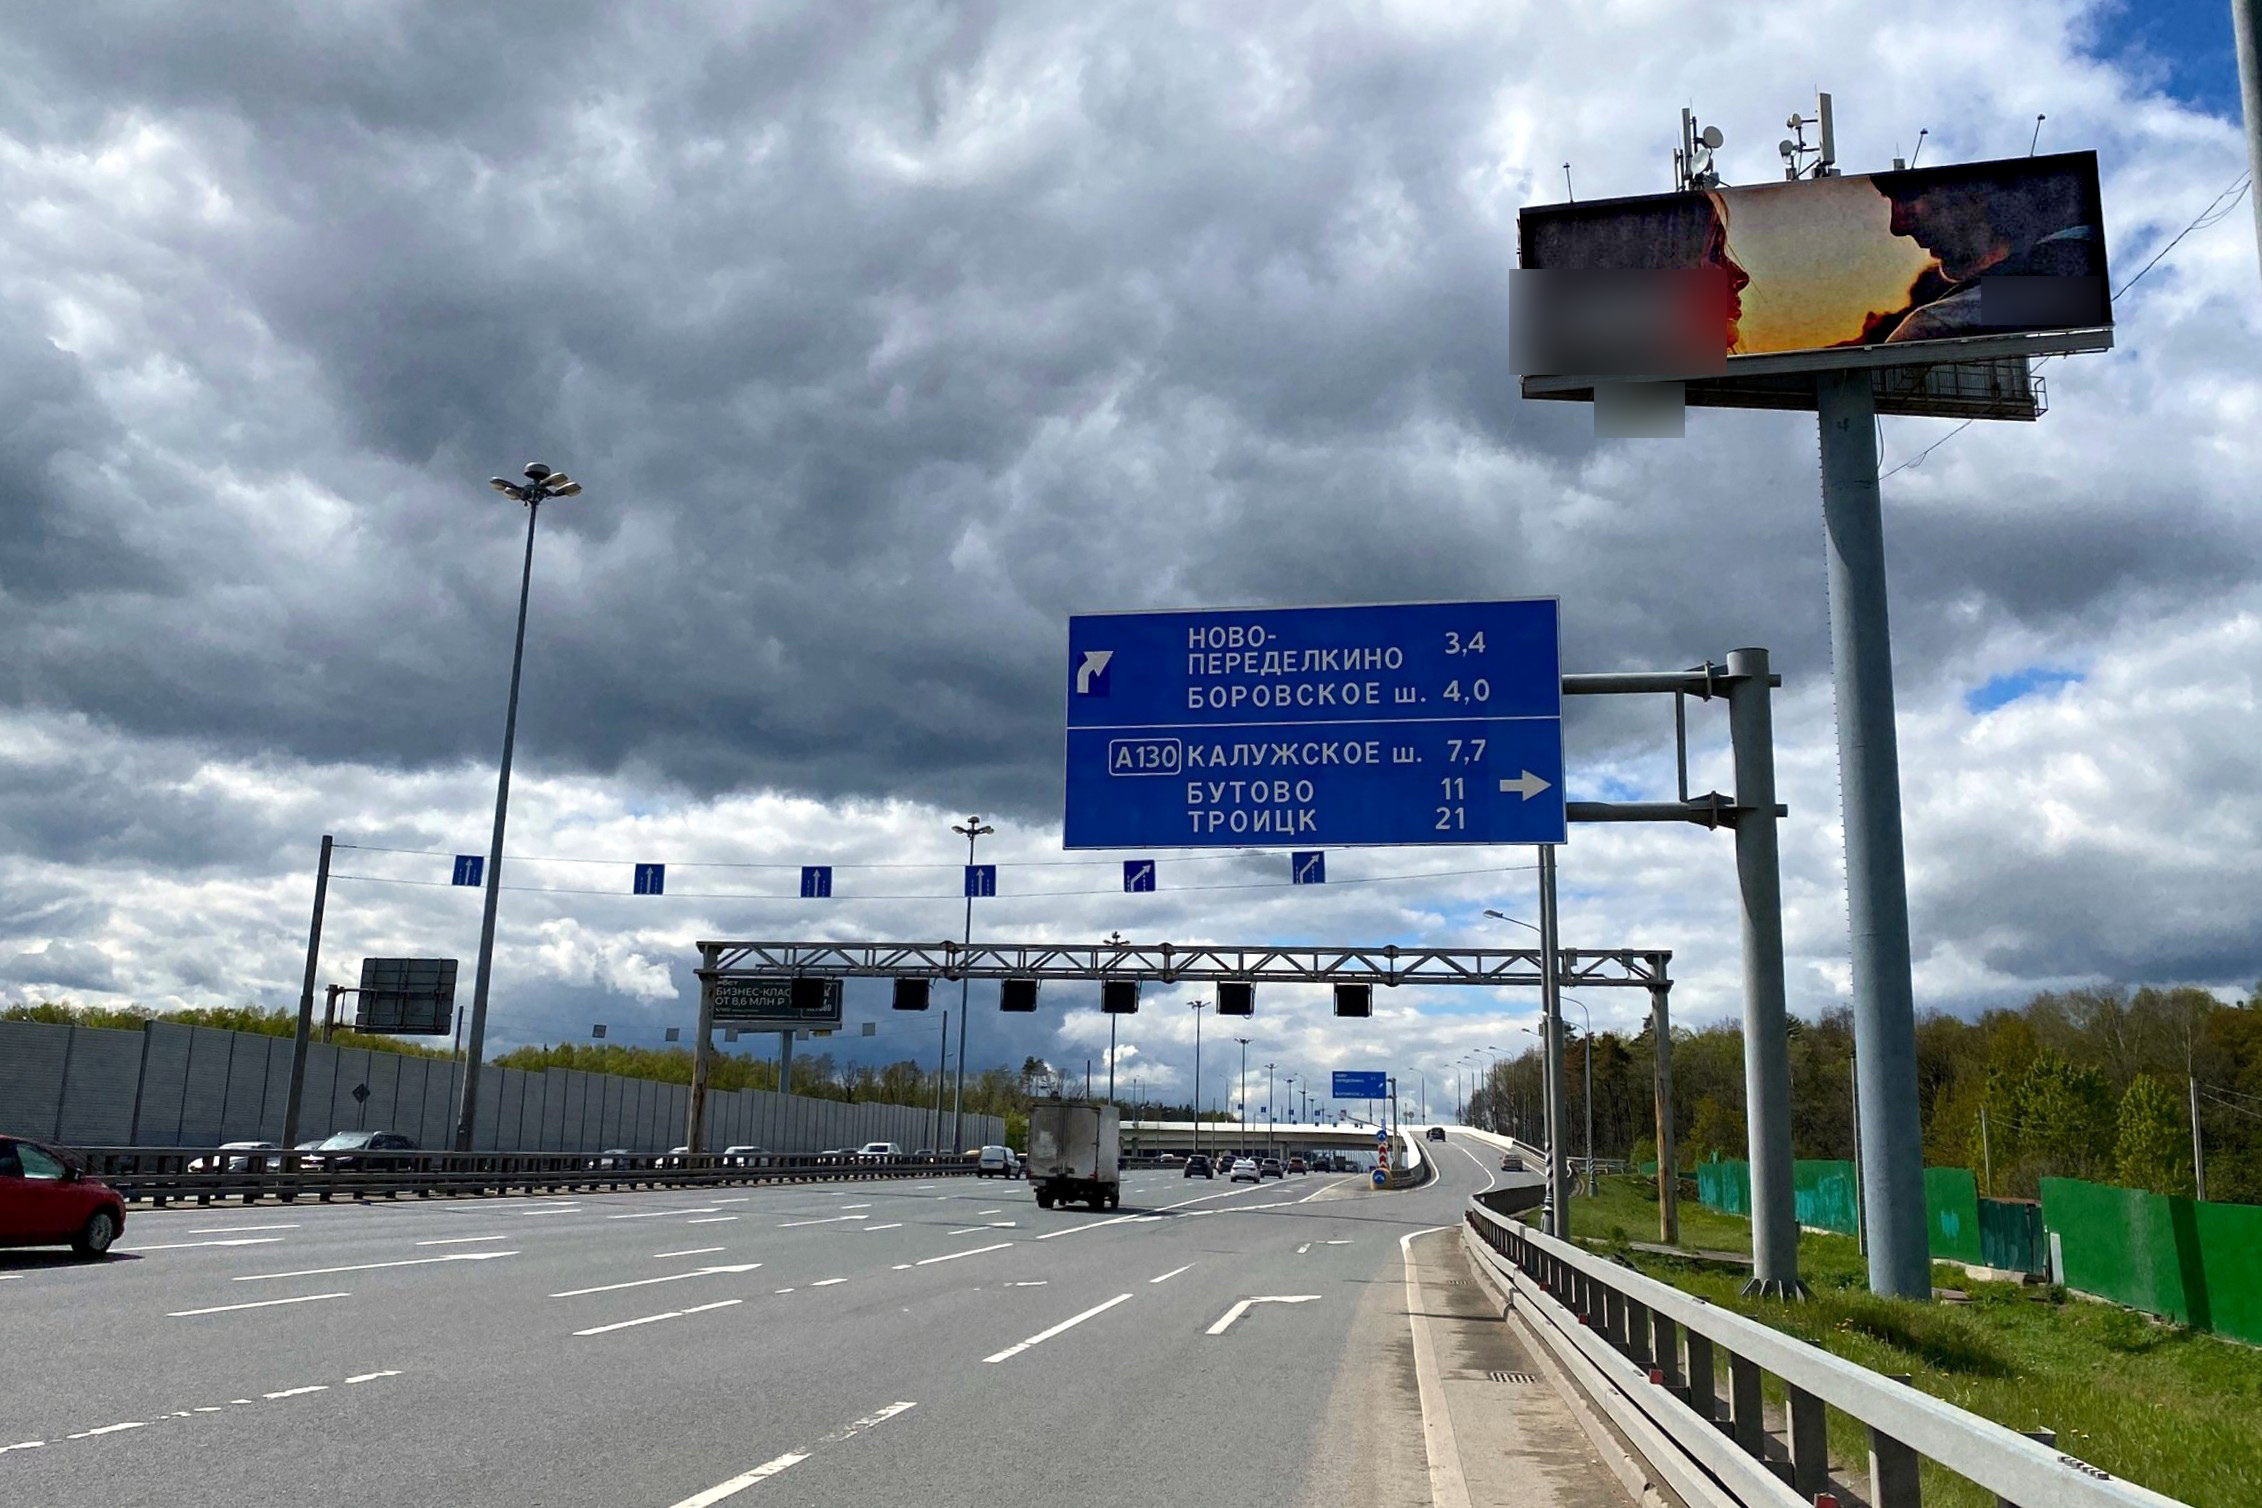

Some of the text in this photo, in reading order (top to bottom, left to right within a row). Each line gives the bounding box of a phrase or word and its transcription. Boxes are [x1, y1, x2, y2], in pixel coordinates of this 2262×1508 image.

[1188, 625, 1277, 649] НОВО-
[1445, 631, 1486, 656] 3,4
[1188, 646, 1403, 676] ПЕРЕДЕЛКИНО
[1188, 678, 1490, 709] БОРОВСКОЕ ш. 4,0
[1115, 739, 1486, 768] А130 КАЛУЖСКОЕ ш. 7,7
[1187, 777, 1464, 804] БУТОВО 11
[1187, 806, 1465, 836] ТРОИЦК 21
[714, 996, 730, 1006] ОТ
[749, 997, 775, 1006] МЛН
[716, 987, 791, 997] БИЗНЕС-КЛАС
